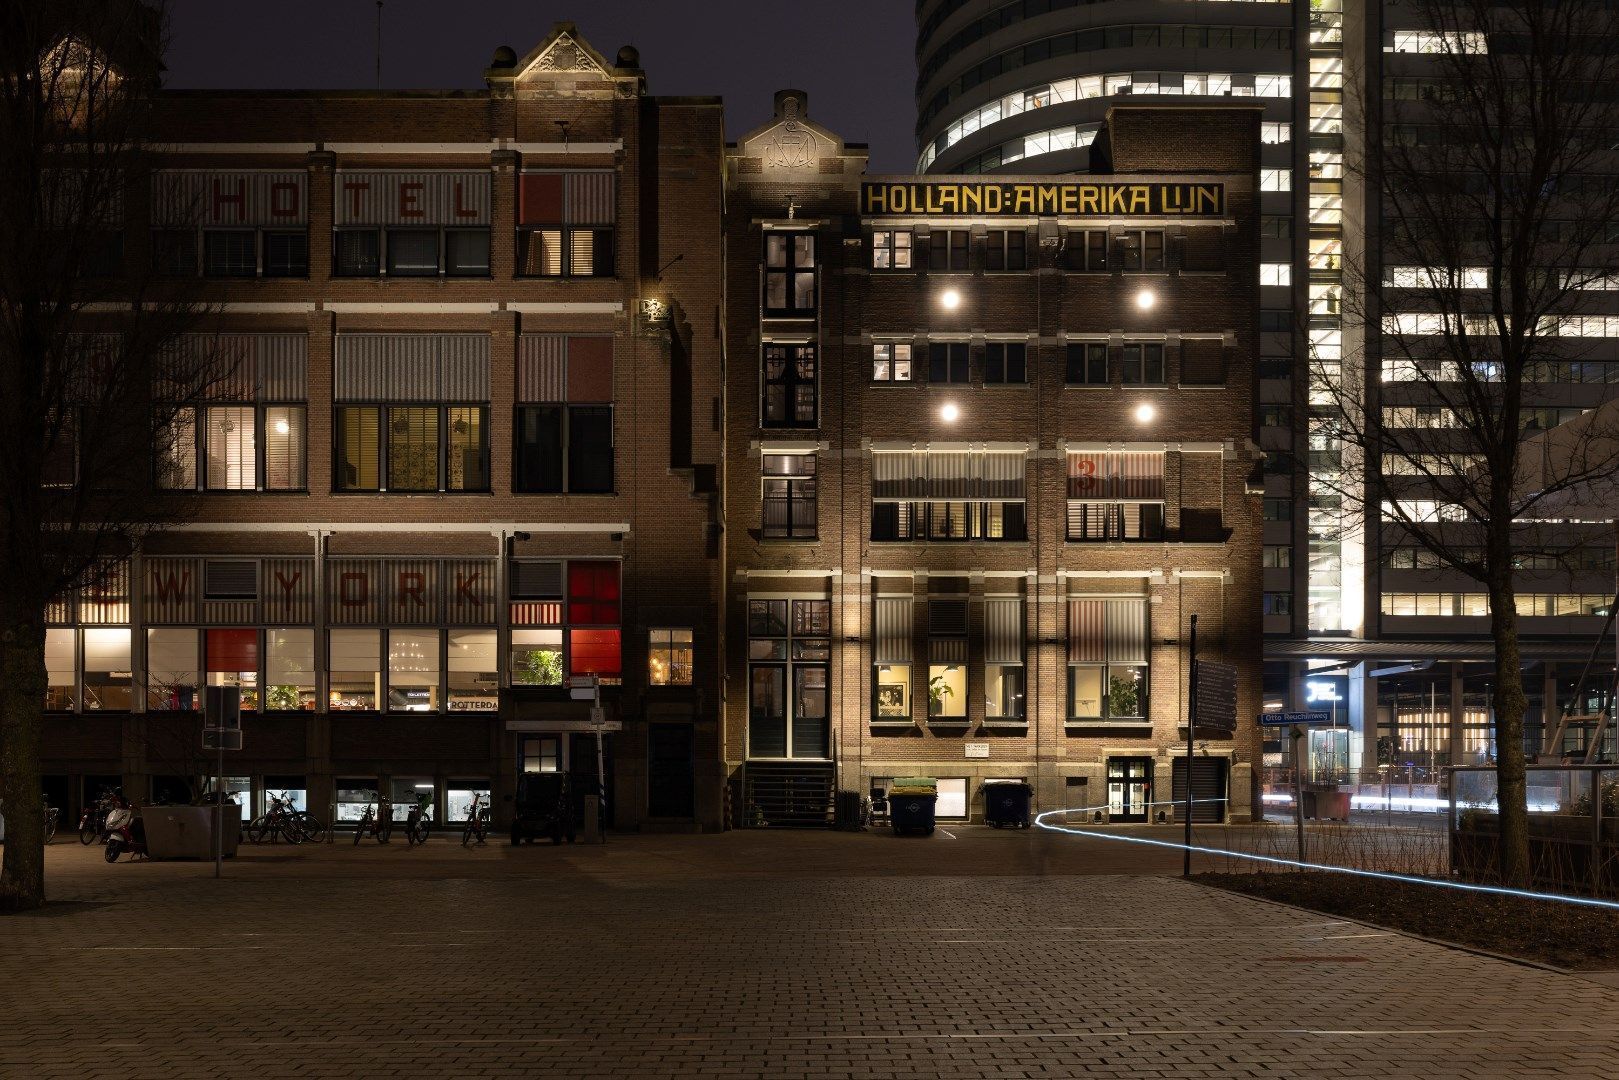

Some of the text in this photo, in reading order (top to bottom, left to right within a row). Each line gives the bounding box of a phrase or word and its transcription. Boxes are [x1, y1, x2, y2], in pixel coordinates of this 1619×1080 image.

[213, 178, 478, 221] HOTEL
[1077, 460, 1096, 490] 3
[275, 571, 482, 612] YORK
[1265, 712, 1328, 722] Otto Reuchlinweg
